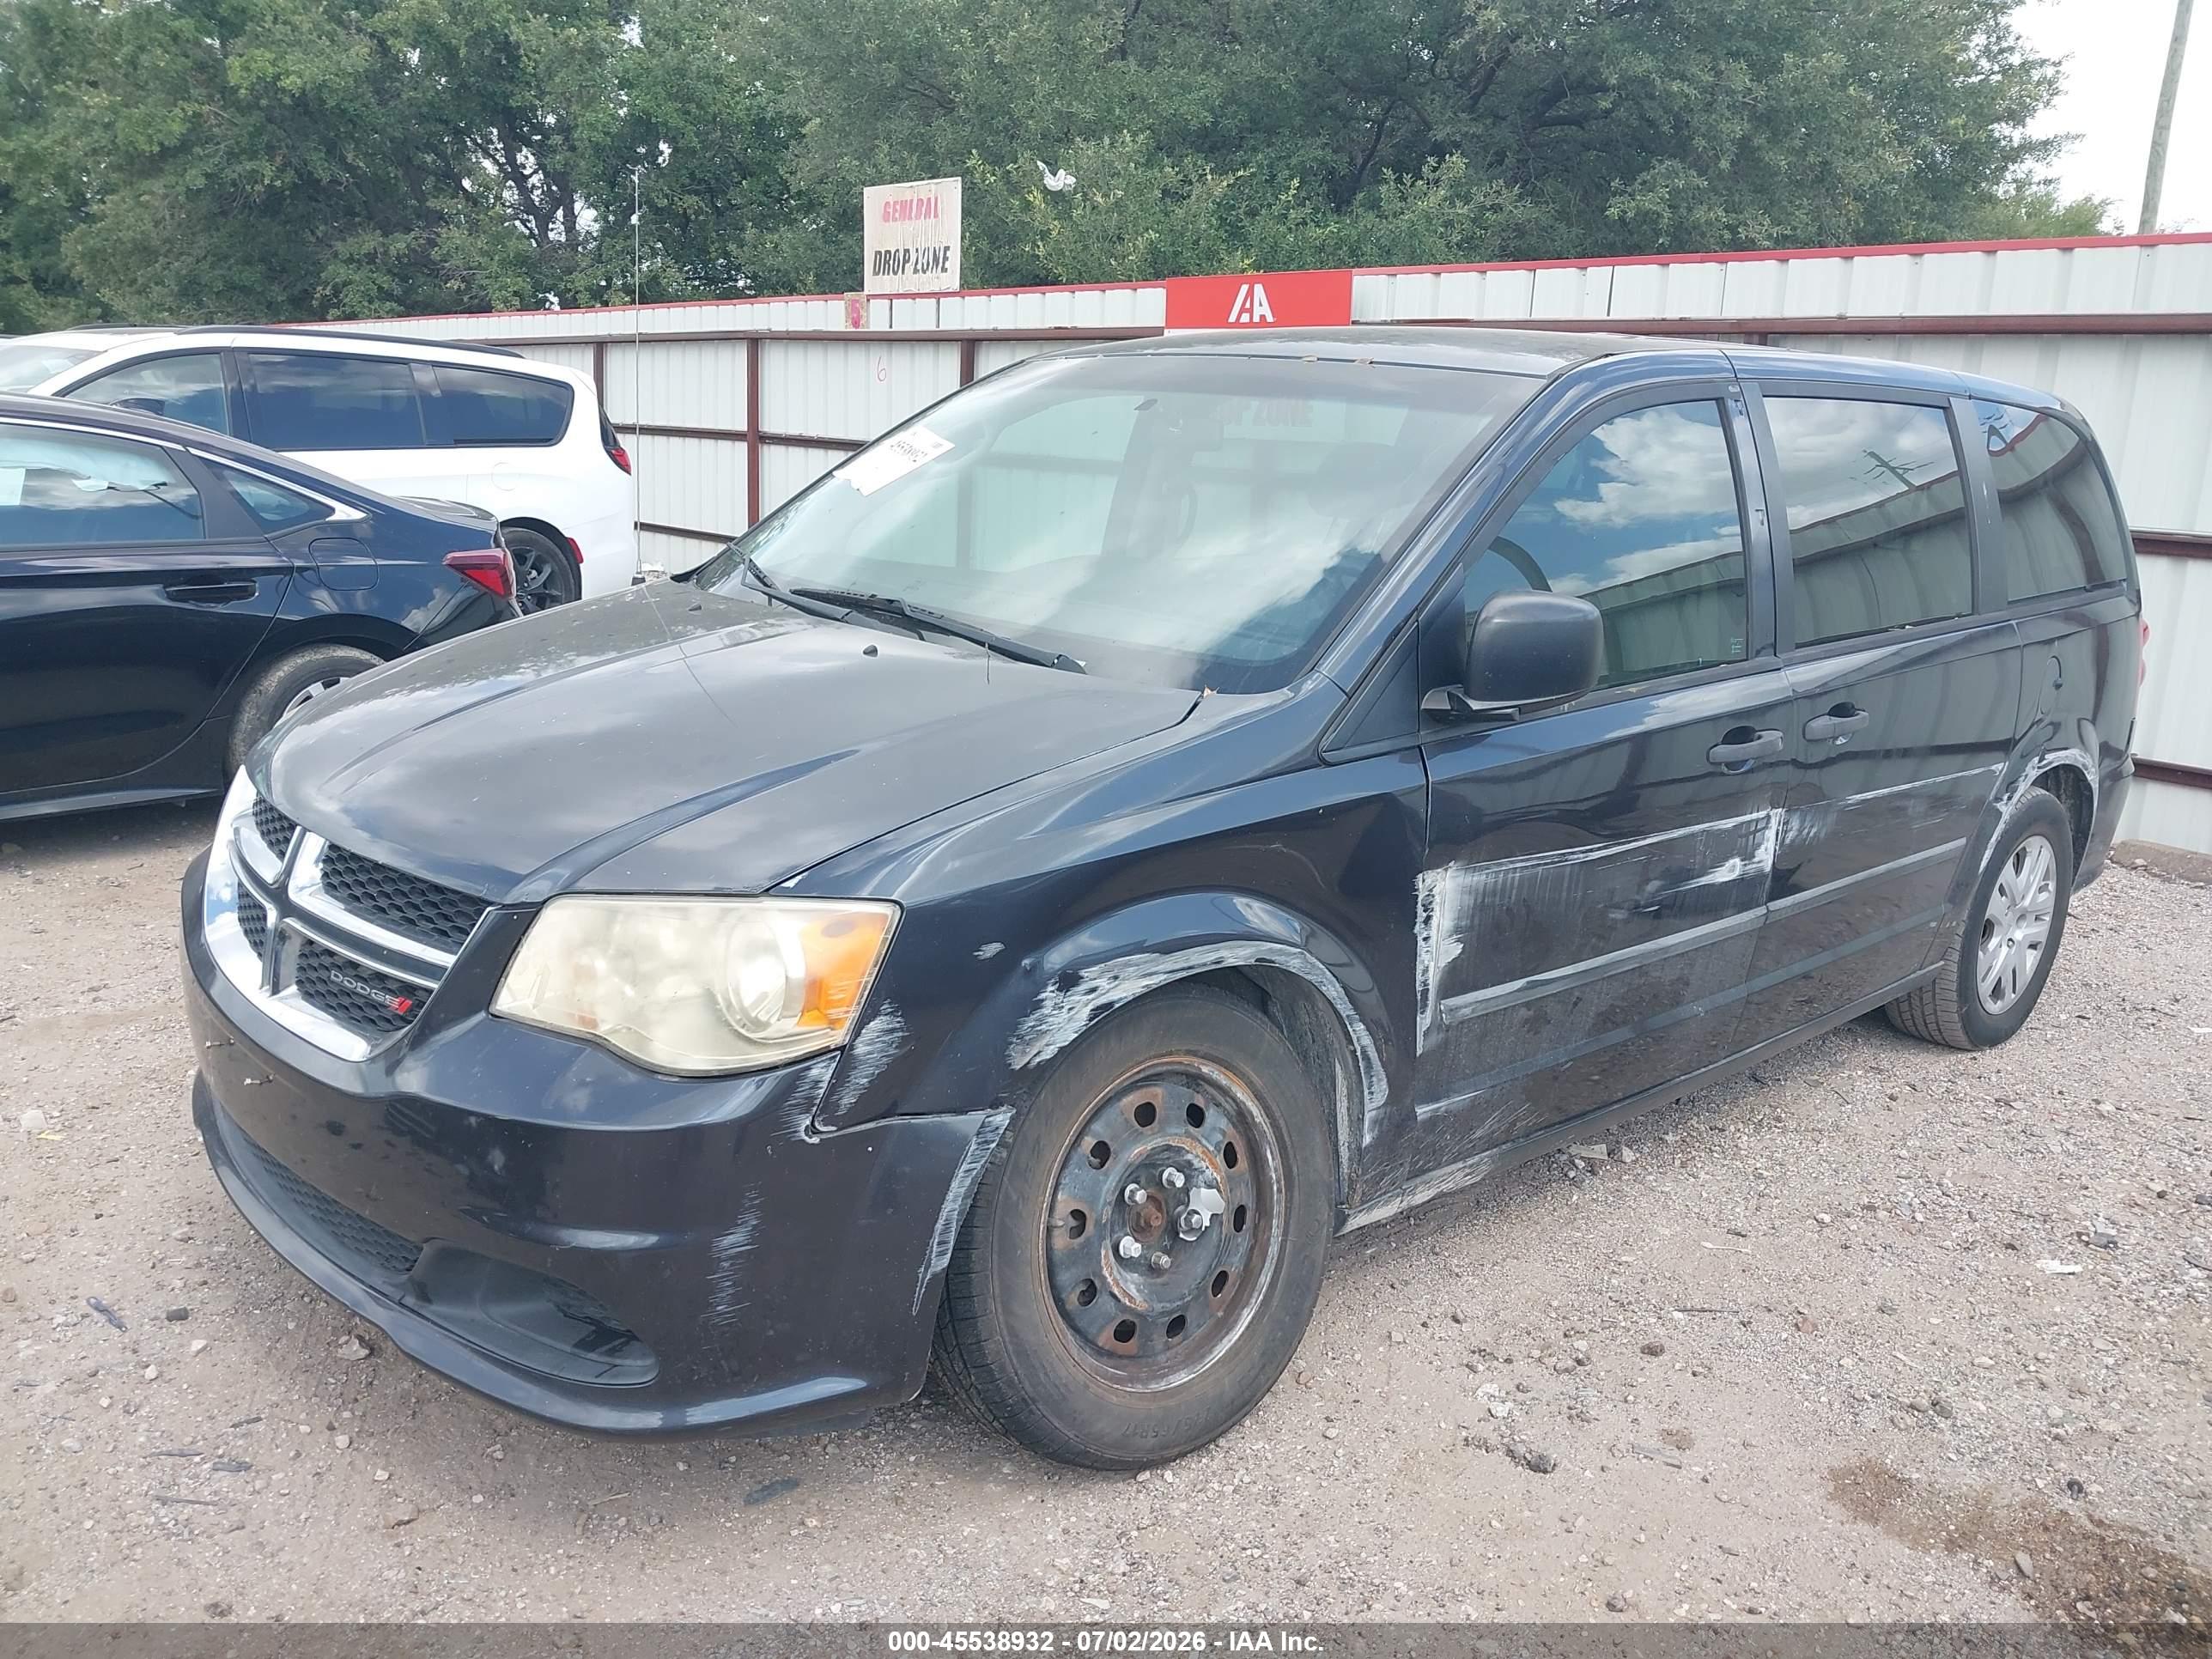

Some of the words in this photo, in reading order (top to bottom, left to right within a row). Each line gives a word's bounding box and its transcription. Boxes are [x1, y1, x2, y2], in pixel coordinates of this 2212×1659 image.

[882, 196, 939, 223] GENERAL
[872, 247, 911, 276] DROP
[912, 246, 951, 275] ZONE
[877, 356, 887, 382] 6
[330, 969, 400, 1009] DODGE
